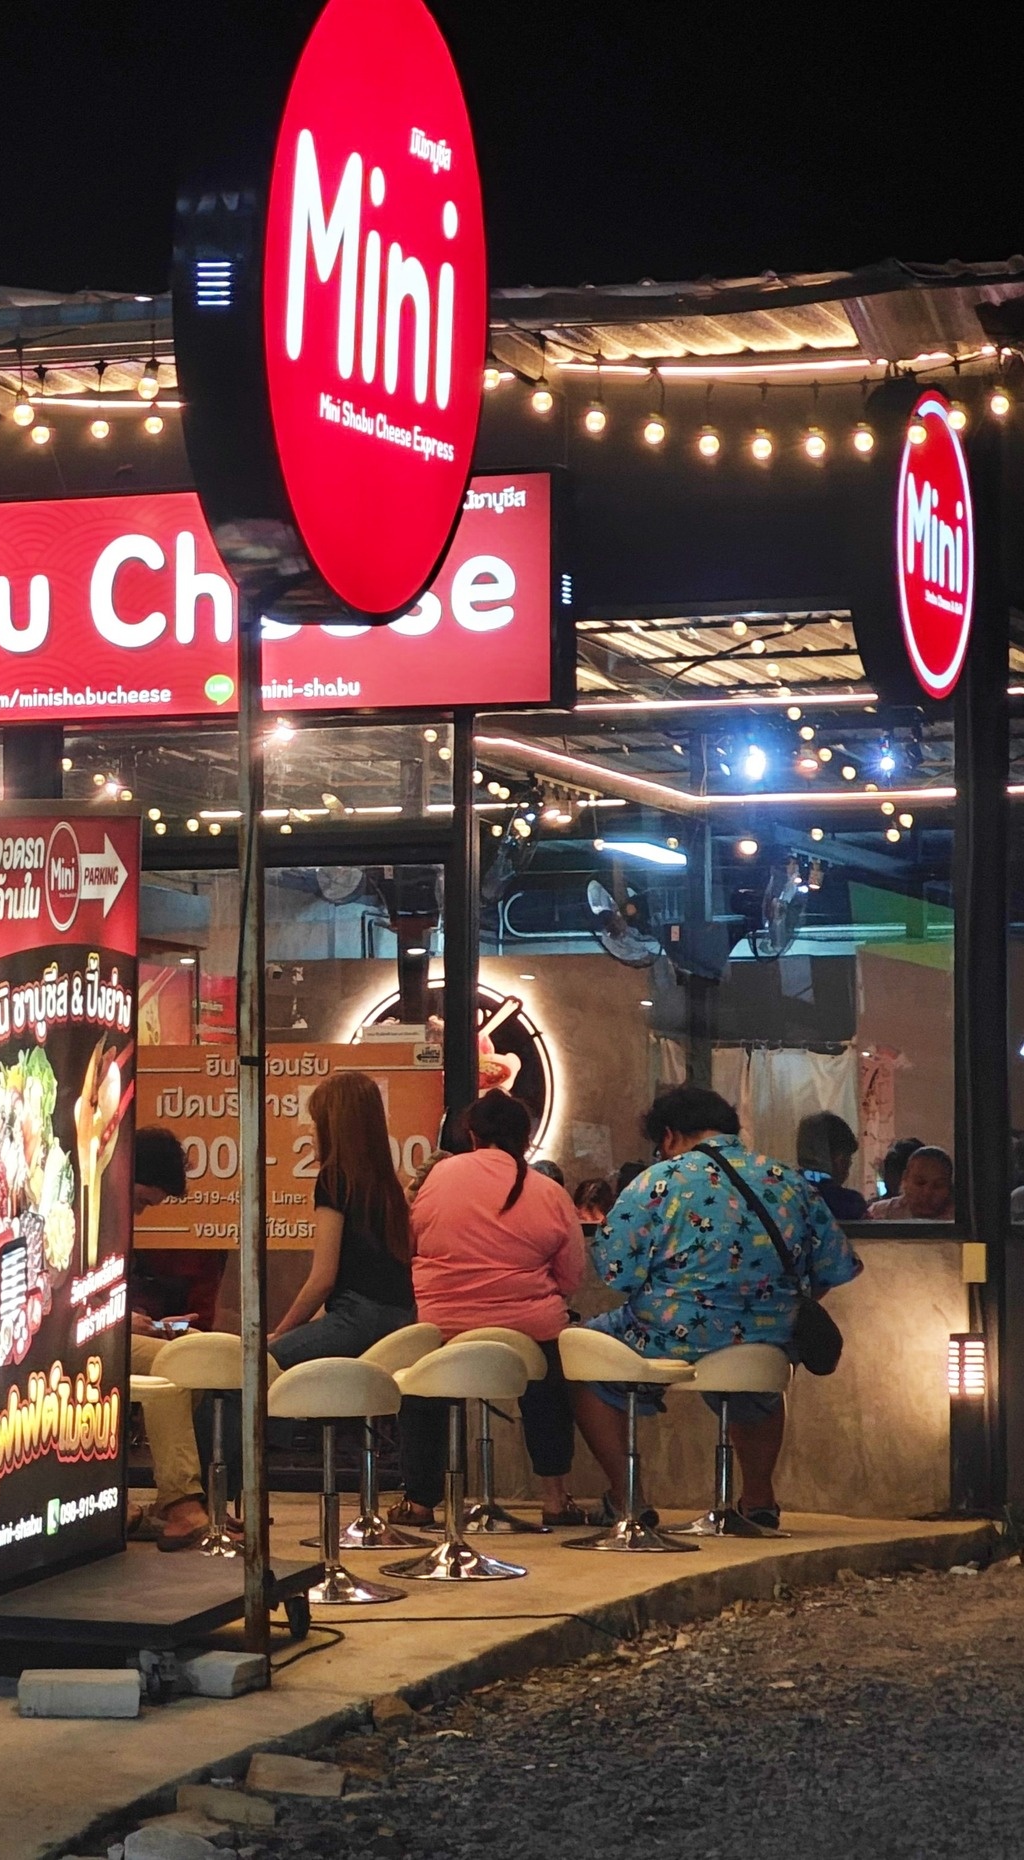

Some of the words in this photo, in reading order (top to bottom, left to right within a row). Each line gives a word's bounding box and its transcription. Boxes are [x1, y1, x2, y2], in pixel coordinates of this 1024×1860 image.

[285, 128, 458, 410] Mini
[319, 391, 341, 424] Mini
[342, 400, 375, 436] Shabu
[376, 412, 412, 448] Cheese
[413, 425, 455, 462] Express
[906, 471, 964, 595] Mini
[261, 676, 360, 699] mini-shabu
[50, 857, 75, 891] Mini
[83, 865, 119, 887] PARKING
[12, 965, 69, 1038] ชาบูชีส
[70, 975, 84, 1017] &
[85, 956, 132, 1029] ปิ้งย่าง
[156, 1087, 299, 1118] เปิดบริาร
[271, 1190, 308, 1206] Line:
